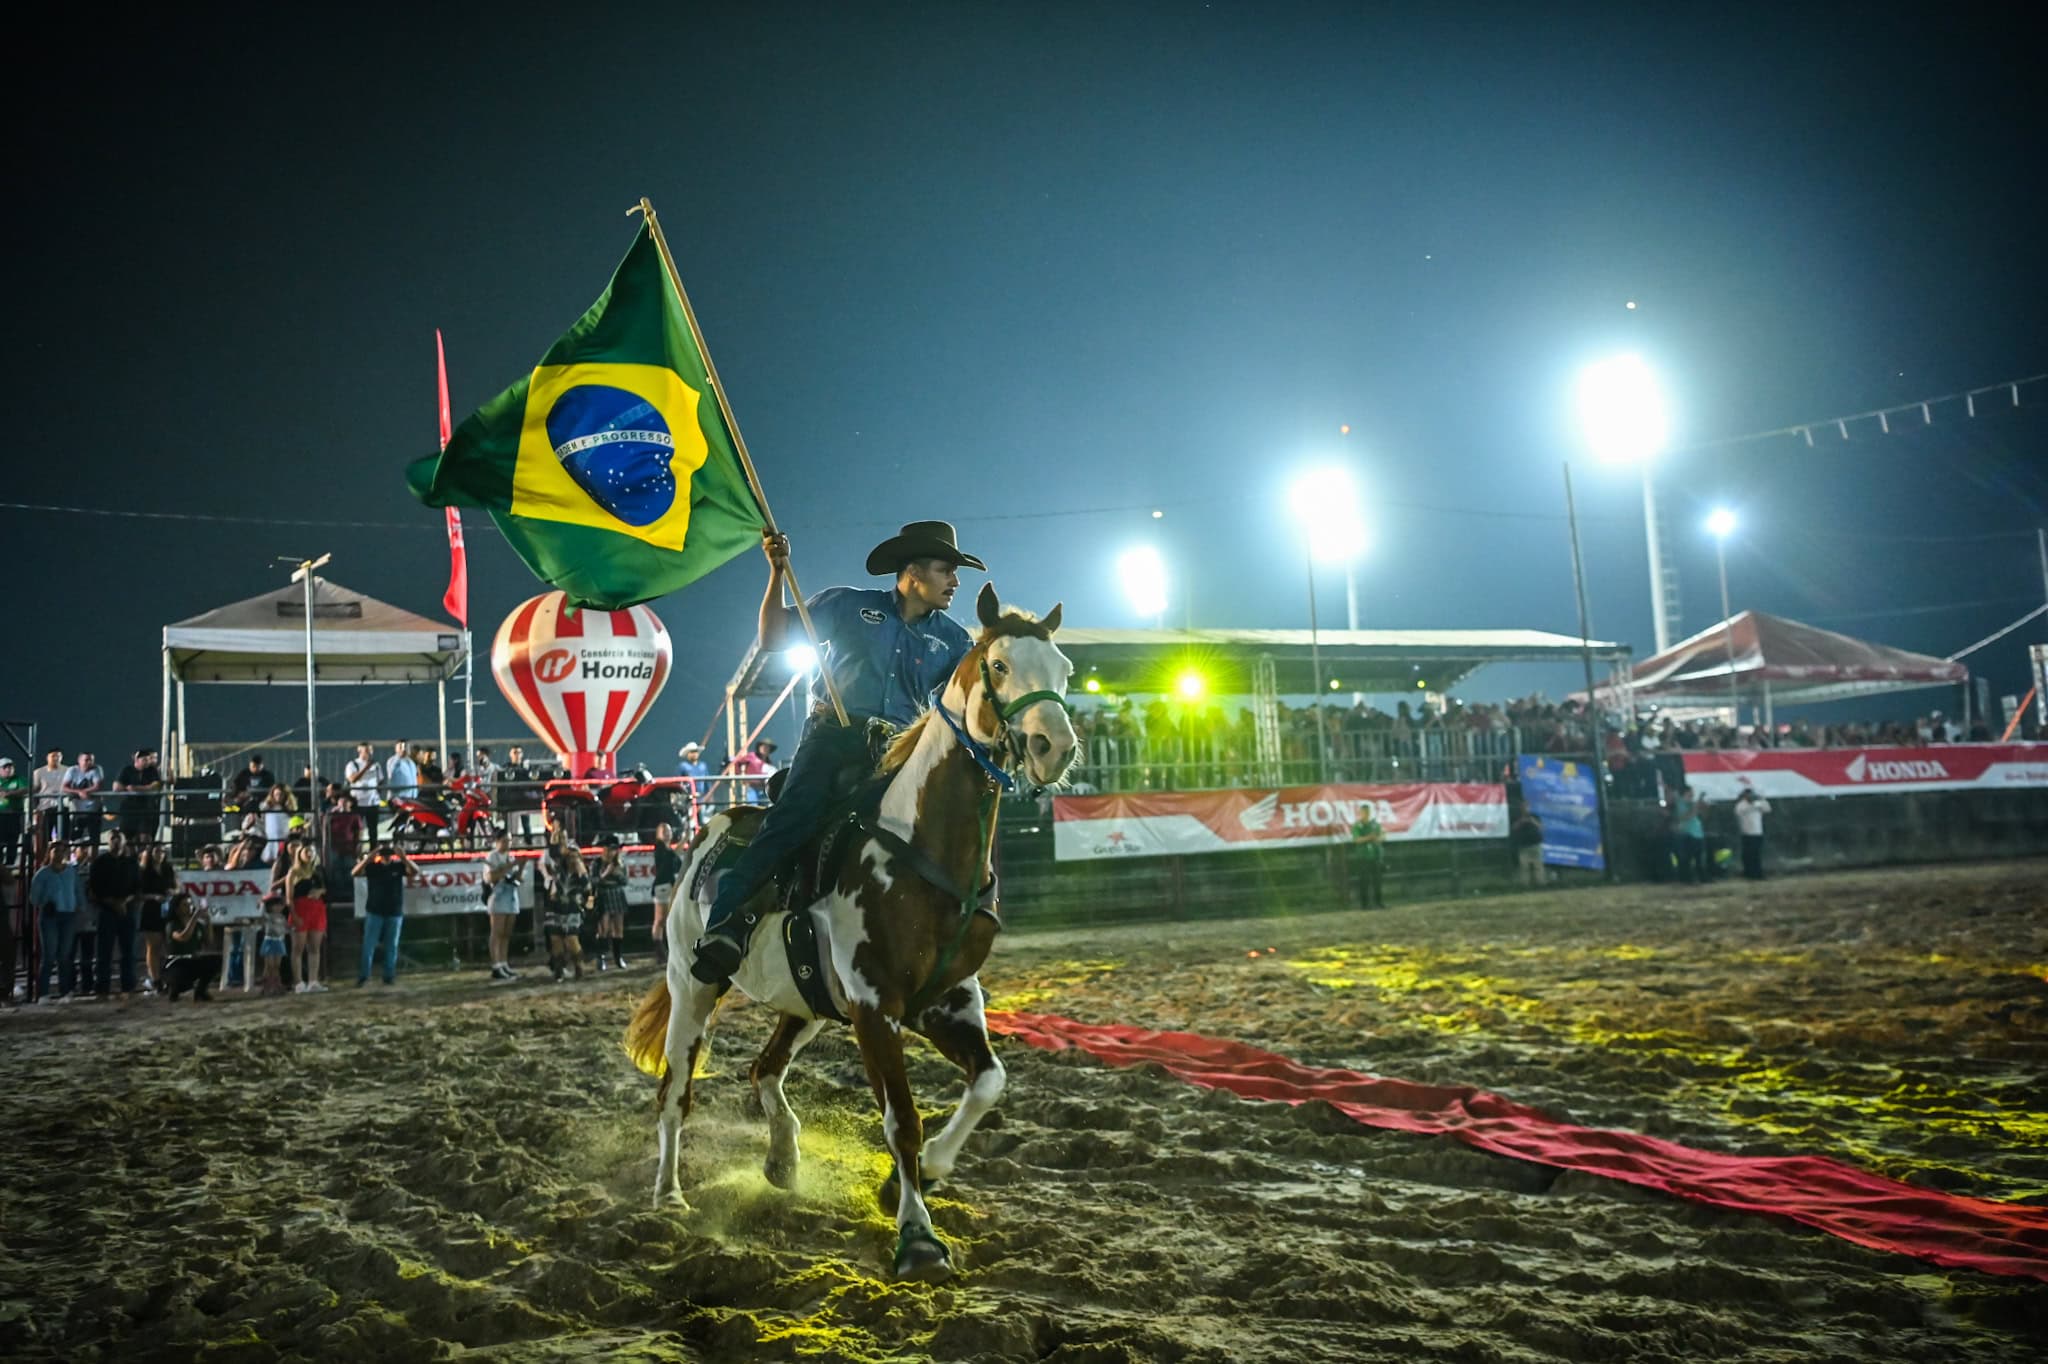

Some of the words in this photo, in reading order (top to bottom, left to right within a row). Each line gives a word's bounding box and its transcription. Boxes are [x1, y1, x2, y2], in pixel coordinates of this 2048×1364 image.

[593, 431, 671, 445] PROGRESSO
[582, 661, 653, 679] Honda
[1867, 760, 1949, 780] HONDA
[1281, 799, 1397, 828] HONDA
[183, 880, 262, 896] NDA
[405, 871, 478, 888] HON
[432, 890, 480, 905] Consór
